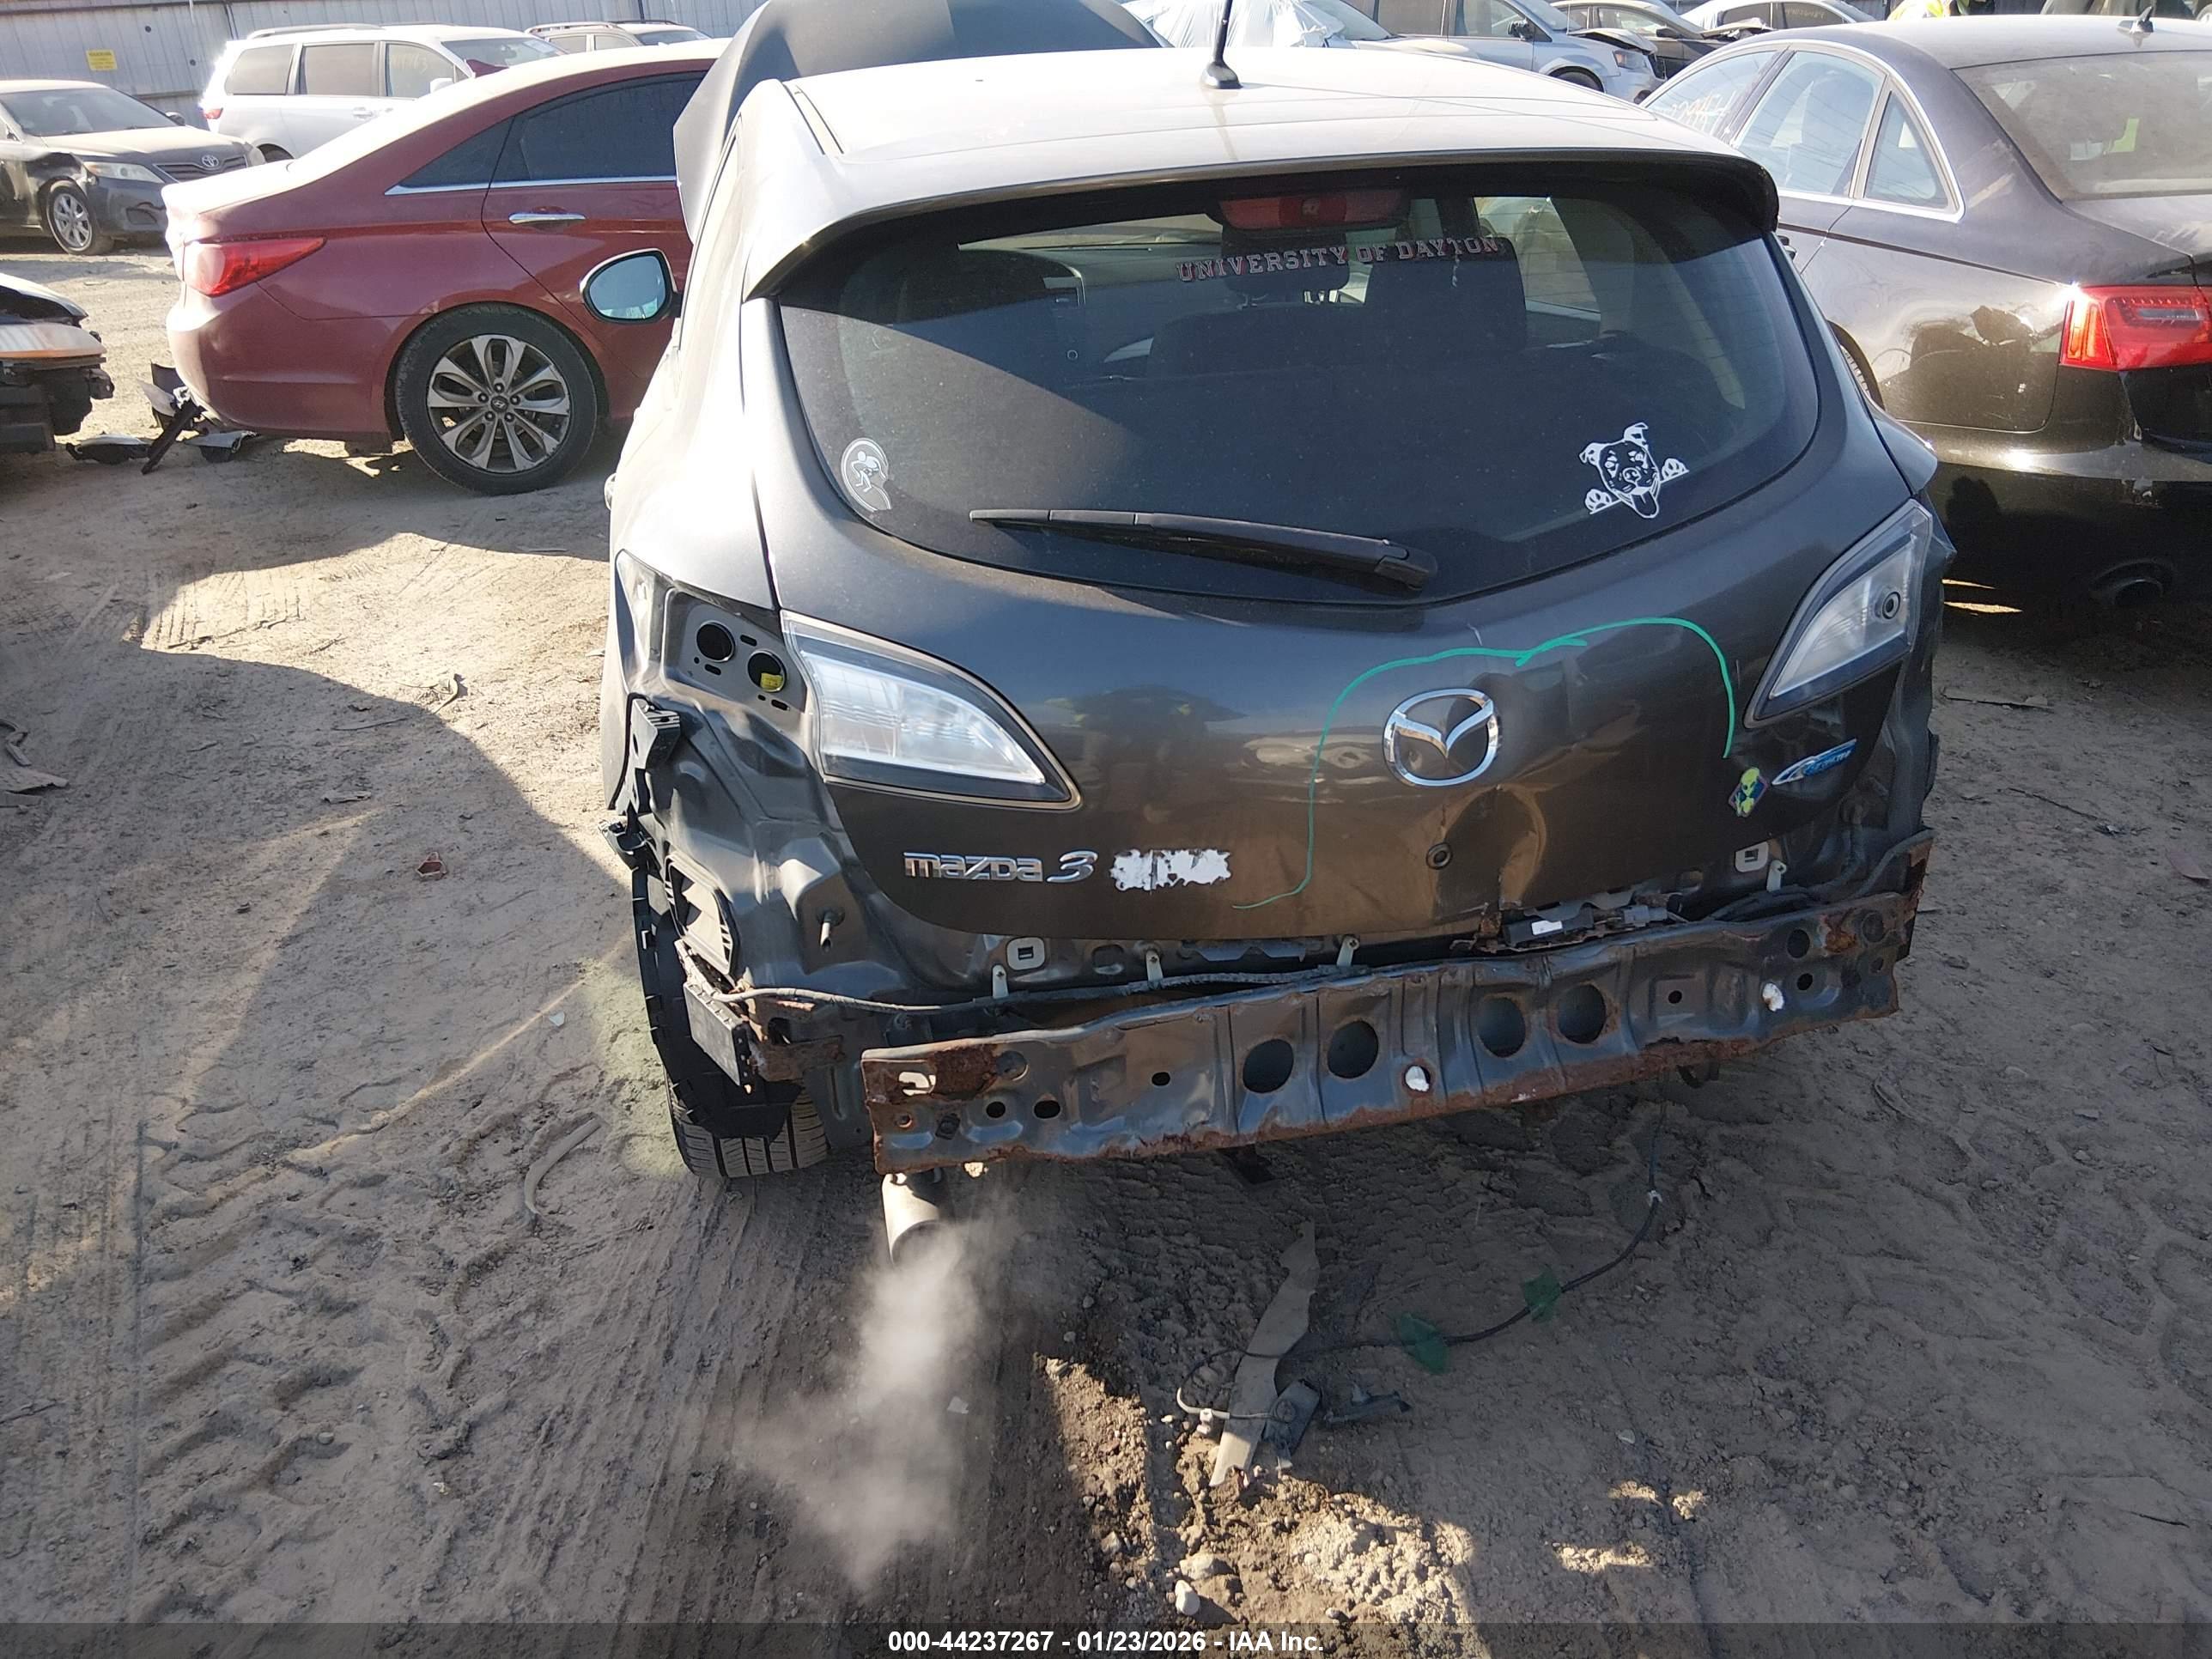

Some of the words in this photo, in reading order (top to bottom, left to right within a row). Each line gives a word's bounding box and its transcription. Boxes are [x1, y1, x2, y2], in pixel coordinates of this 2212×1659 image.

[1176, 246, 1347, 283] UNIVERSITY
[1356, 244, 1388, 264] OF
[1397, 236, 1499, 260] DAYTON
[1046, 850, 1099, 884] 3
